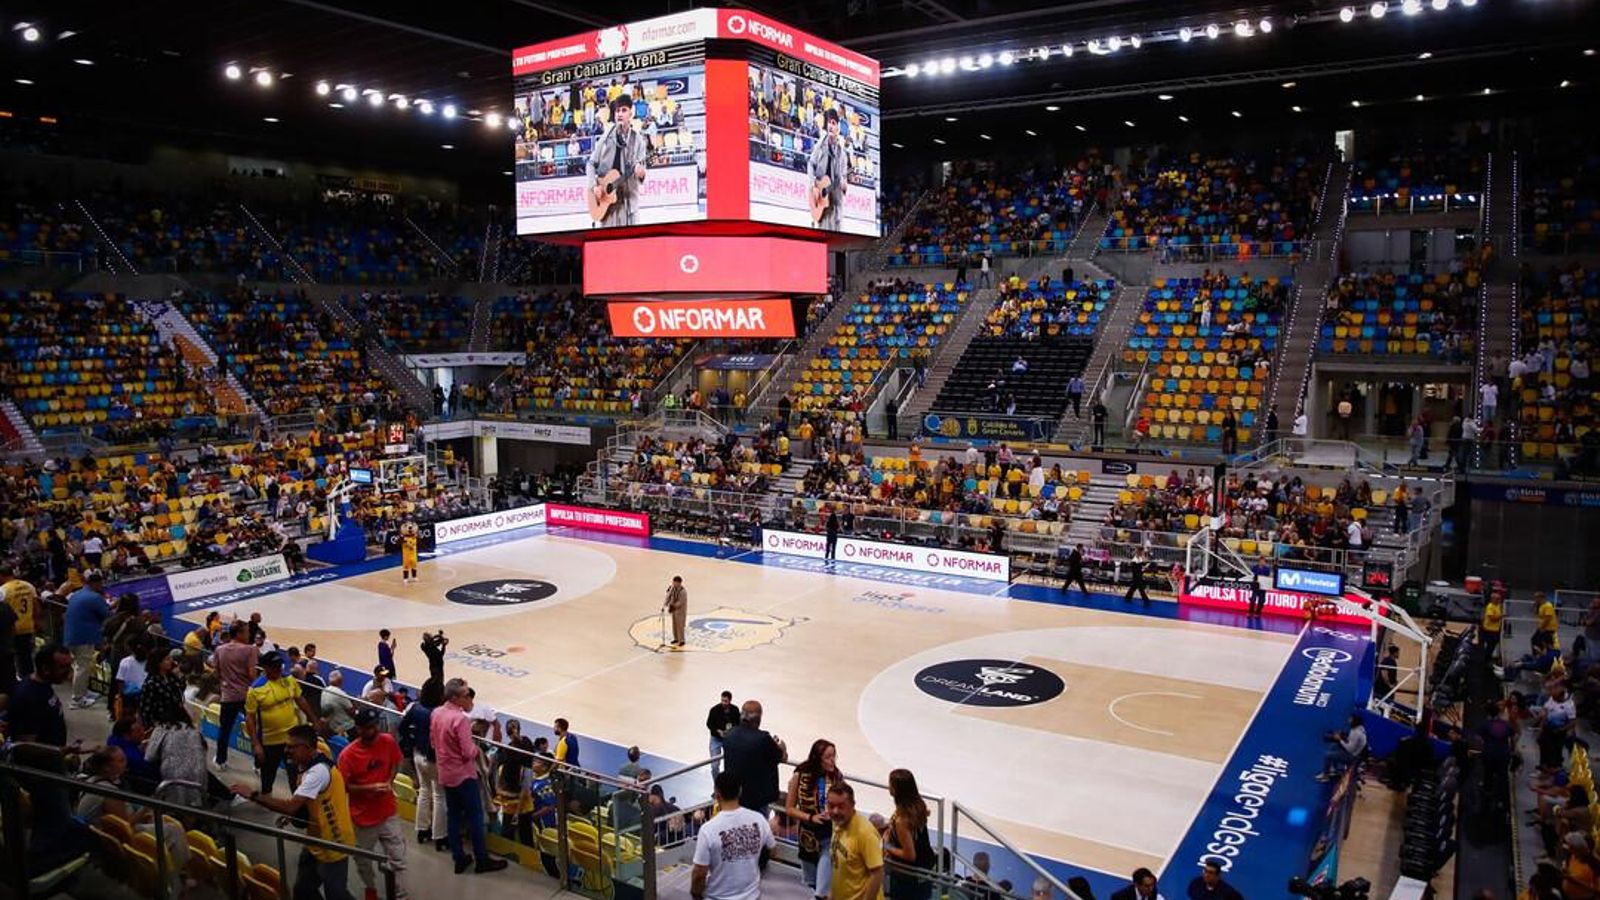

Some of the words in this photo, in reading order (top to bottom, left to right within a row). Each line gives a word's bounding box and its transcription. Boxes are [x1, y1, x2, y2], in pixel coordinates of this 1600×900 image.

[641, 20, 697, 42] nformar.com
[748, 19, 794, 49] NFORMAR
[542, 69, 572, 85] Gran
[573, 59, 623, 80] Canaria
[624, 50, 666, 70] Arena
[776, 53, 801, 72] Gran
[802, 63, 839, 87] Canaria
[639, 175, 690, 198] ORMAR
[751, 174, 807, 200] NFORMAR
[519, 186, 585, 209] NFORMAR
[843, 192, 873, 213] RMAR
[658, 307, 767, 331] NFORMAR
[390, 430, 404, 443] 24
[449, 518, 493, 535] NFORMAR
[505, 508, 545, 525] NFORMAR
[781, 536, 830, 554] NFORMA
[858, 546, 914, 564] NFORMAR
[942, 556, 1002, 575] NFORMAR
[20, 598, 28, 614] 3
[1256, 590, 1299, 609] UTURO
[461, 643, 507, 659] liga
